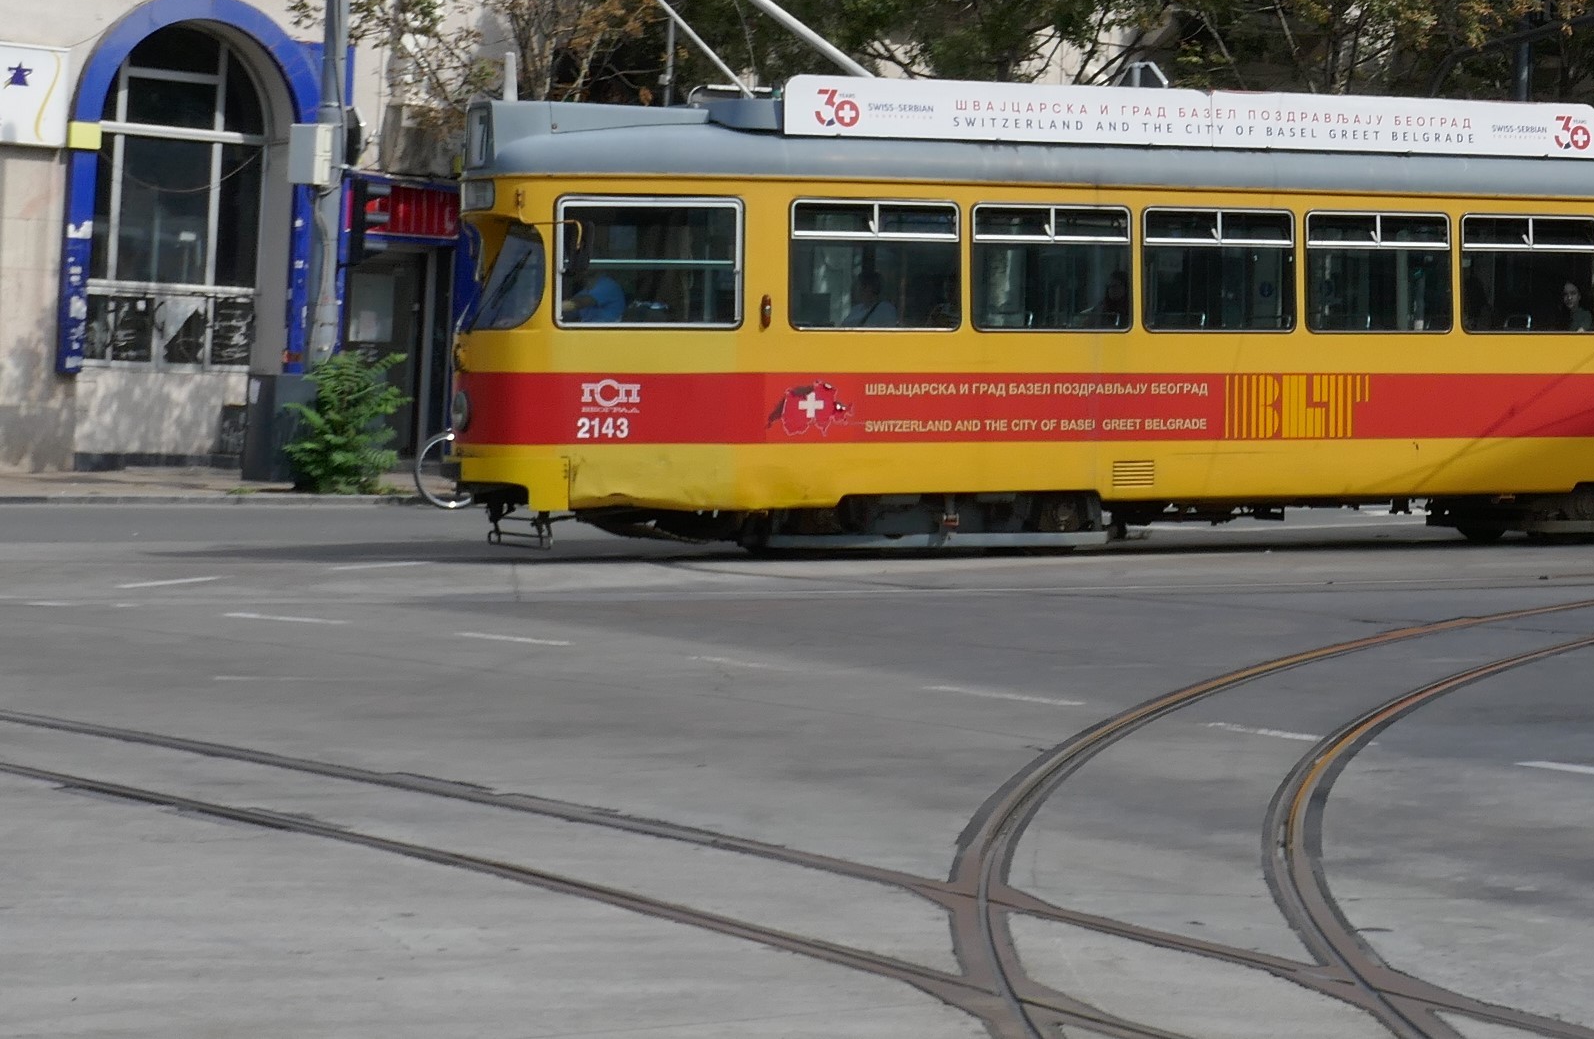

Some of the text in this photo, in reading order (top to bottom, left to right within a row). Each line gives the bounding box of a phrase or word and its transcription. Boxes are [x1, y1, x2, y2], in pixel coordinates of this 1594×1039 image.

[955, 100, 1472, 130] ШВАЈЦАРСКА И ГРАД БАЗЕЛ ПОЗДРАВЉАЈУ БЕОГРАД
[953, 117, 1475, 144] SWITZERLAND AND THE CITY OF BASEL GREET BELGRADE
[581, 379, 641, 407] ГСП
[865, 383, 1209, 397] ШВАЈЦАРСКА И ГРАД БАЗЕЛ ПОЗДРАВЉАЈУ БЕОГРАД
[577, 418, 629, 438] 2143
[865, 420, 952, 432] SWITZERLAND
[954, 420, 981, 432] AND
[984, 419, 1008, 431] THE
[1011, 419, 1038, 431] CITY
[1040, 419, 1057, 431] OF
[1102, 418, 1142, 430] GREET
[1145, 418, 1207, 430] BELGRADE
